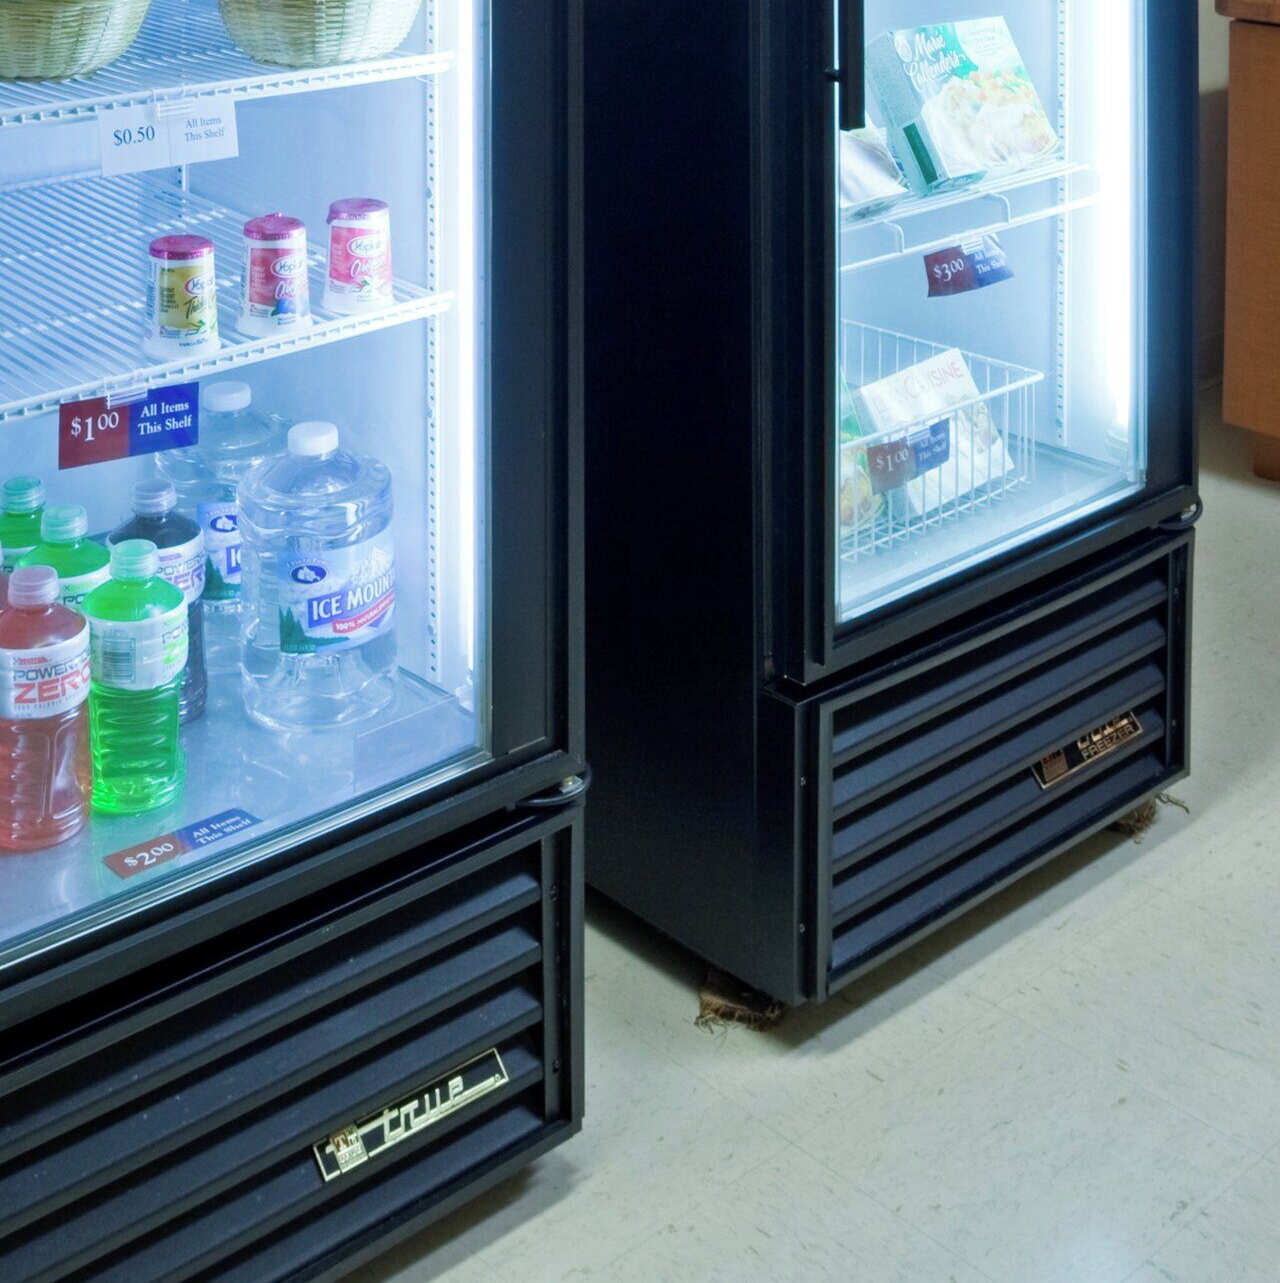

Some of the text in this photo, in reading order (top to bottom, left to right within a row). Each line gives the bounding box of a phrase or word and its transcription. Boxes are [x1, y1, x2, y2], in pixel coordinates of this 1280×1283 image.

[914, 30, 946, 62] Marie
[183, 125, 226, 142] This Shelf
[185, 115, 223, 129] All Items
[113, 123, 156, 148] $0.50
[141, 398, 190, 418] All Items
[137, 415, 192, 435] This Shelf
[312, 594, 343, 621] ICE
[1080, 723, 1135, 760] FREEZER
[191, 815, 243, 841] All Items
[197, 819, 252, 845] This Shelf
